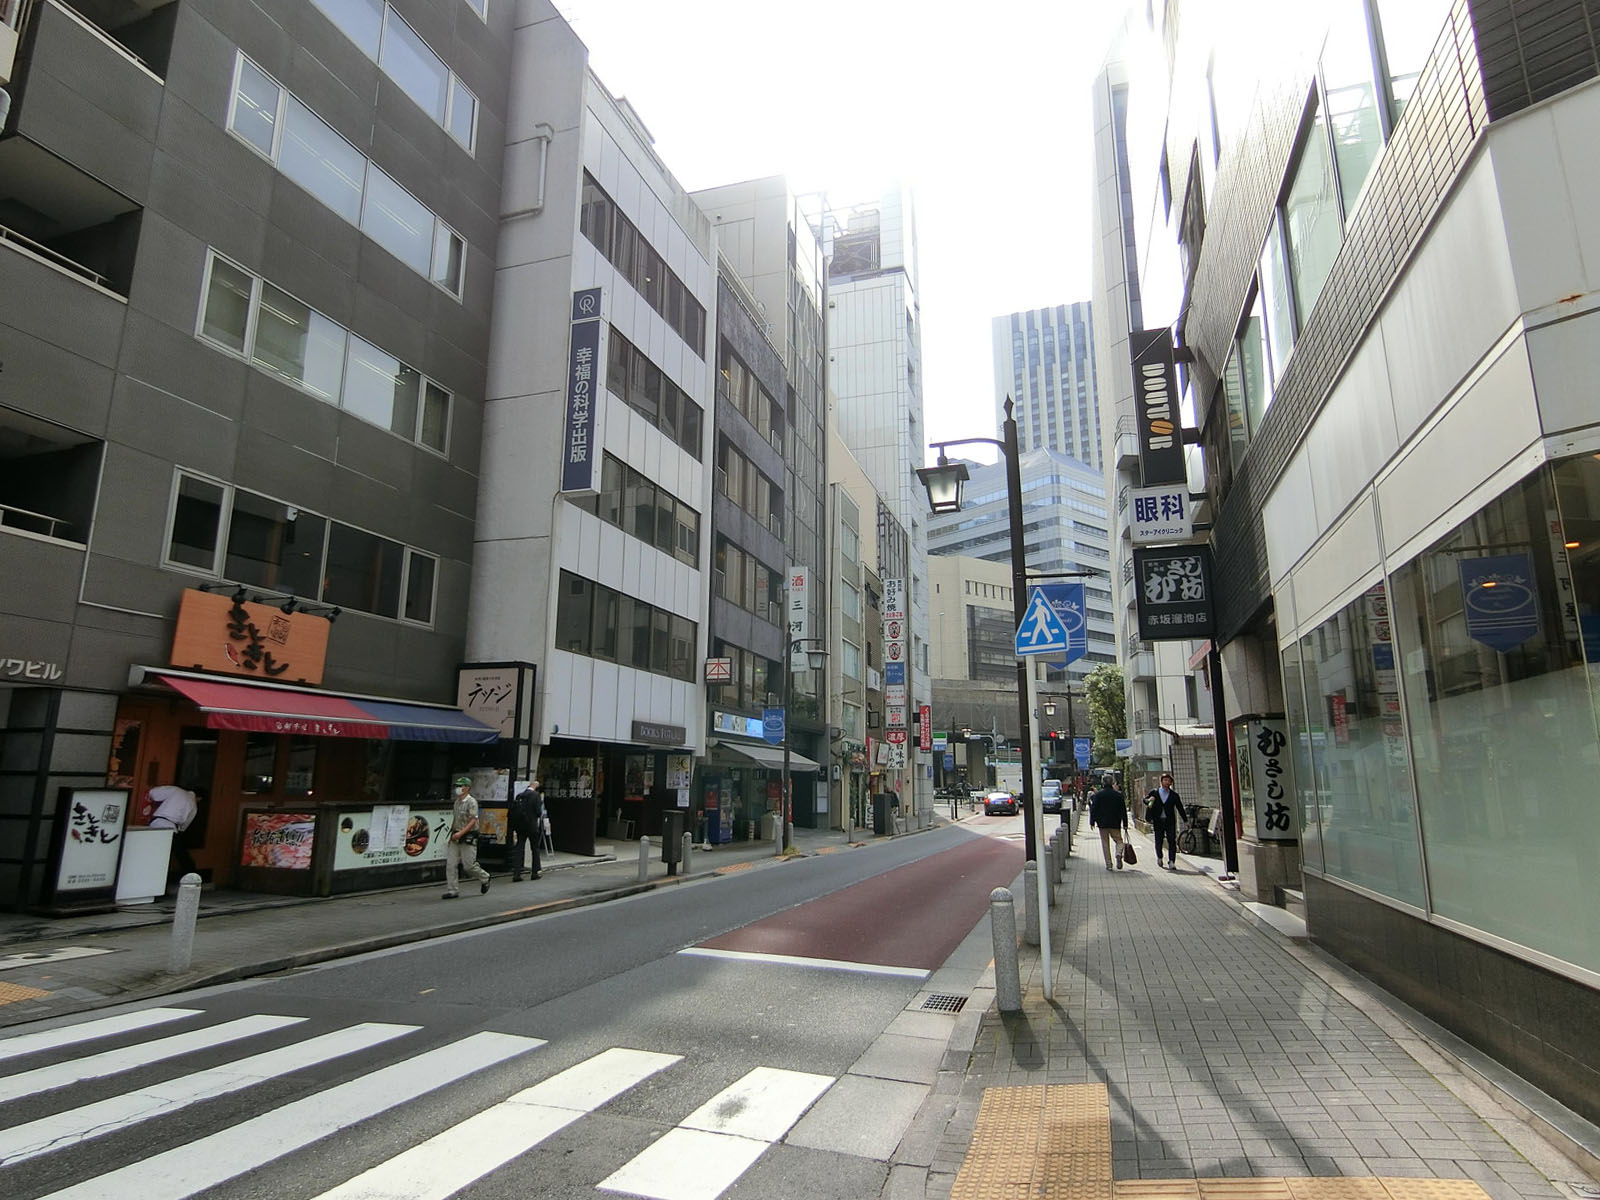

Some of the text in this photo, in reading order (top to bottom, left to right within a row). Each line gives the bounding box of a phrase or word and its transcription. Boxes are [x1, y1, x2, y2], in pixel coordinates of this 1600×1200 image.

[570, 347, 592, 463] 幸福の科学出版
[1142, 362, 1174, 450] DOUTOR
[1134, 493, 1184, 522] 眼科
[1140, 527, 1184, 536] スターアイクリニック
[791, 575, 804, 587] 酒
[886, 580, 896, 611] お好み焼
[791, 600, 804, 653] 三河屋
[1147, 612, 1207, 626] 赤坂溜池店
[0, 658, 62, 680] ワビル
